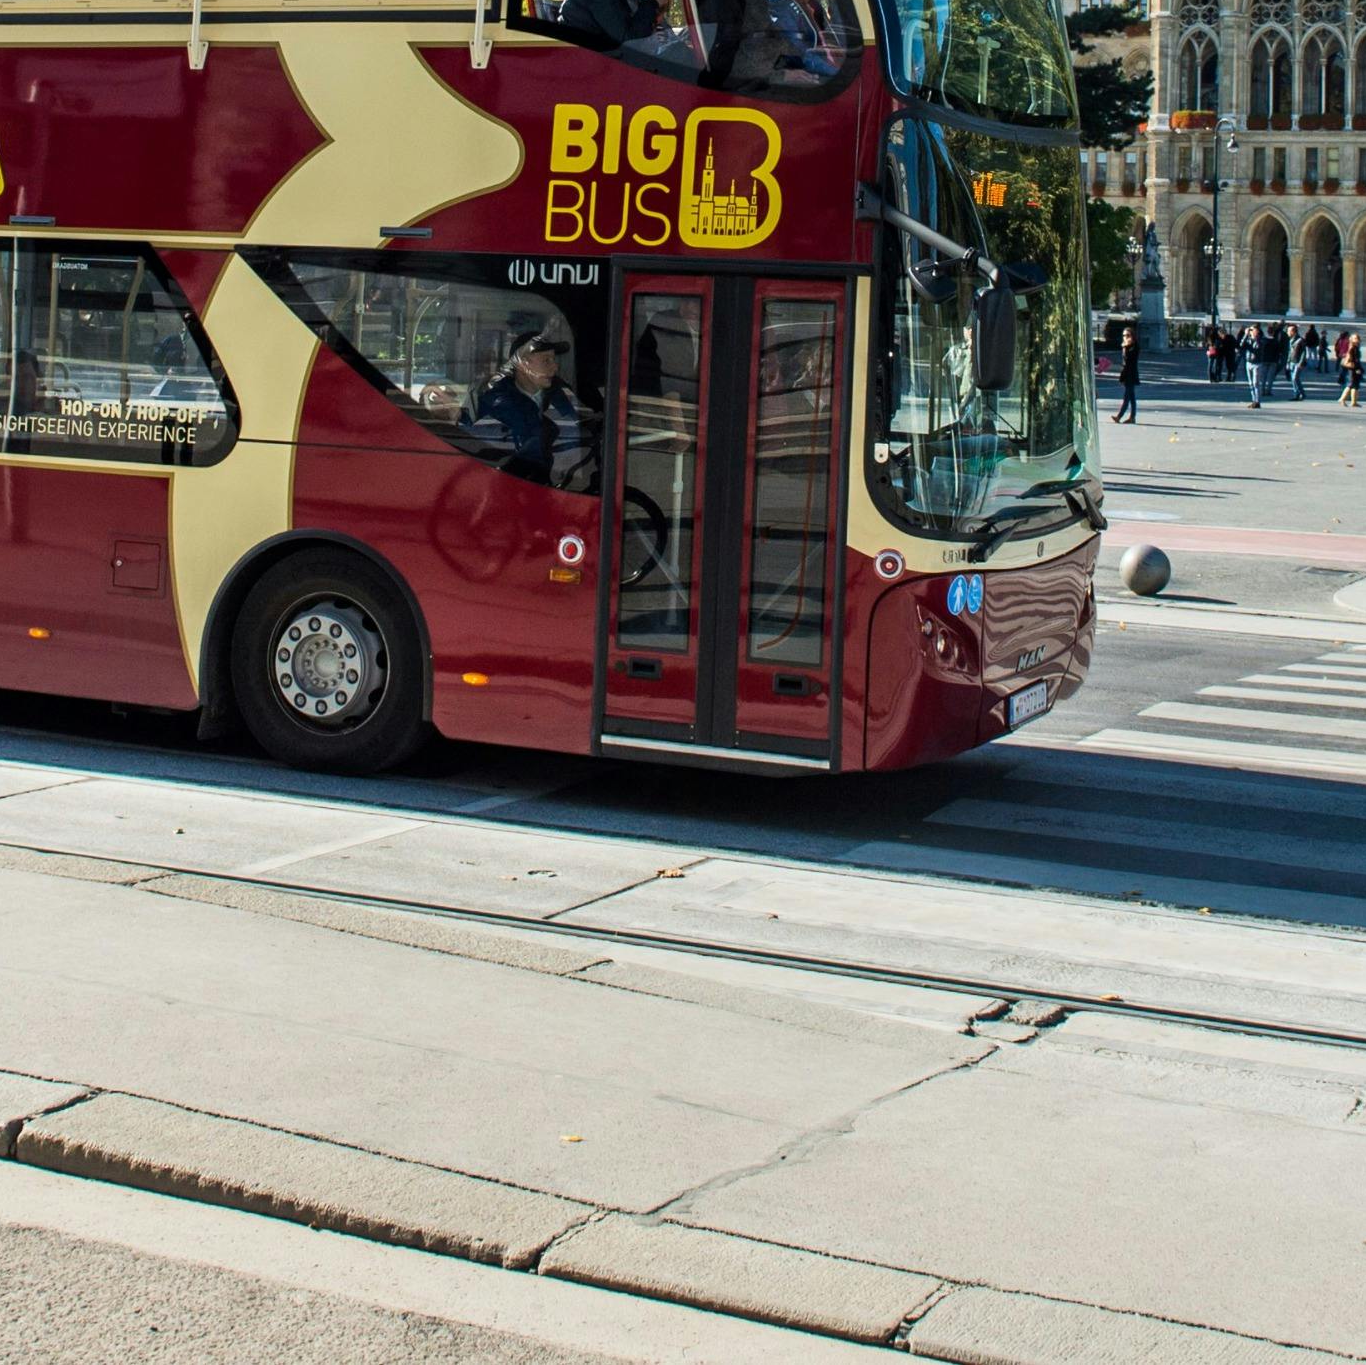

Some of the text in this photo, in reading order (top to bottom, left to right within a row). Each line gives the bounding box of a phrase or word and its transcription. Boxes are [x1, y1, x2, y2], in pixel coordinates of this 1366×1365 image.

[550, 103, 677, 176] BIG
[545, 179, 671, 246] BUS
[61, 400, 122, 420] HOP-ON
[136, 405, 208, 424] HOP-OFF
[98, 421, 197, 445] EXPERIENCE
[1016, 644, 1046, 673] MAN
